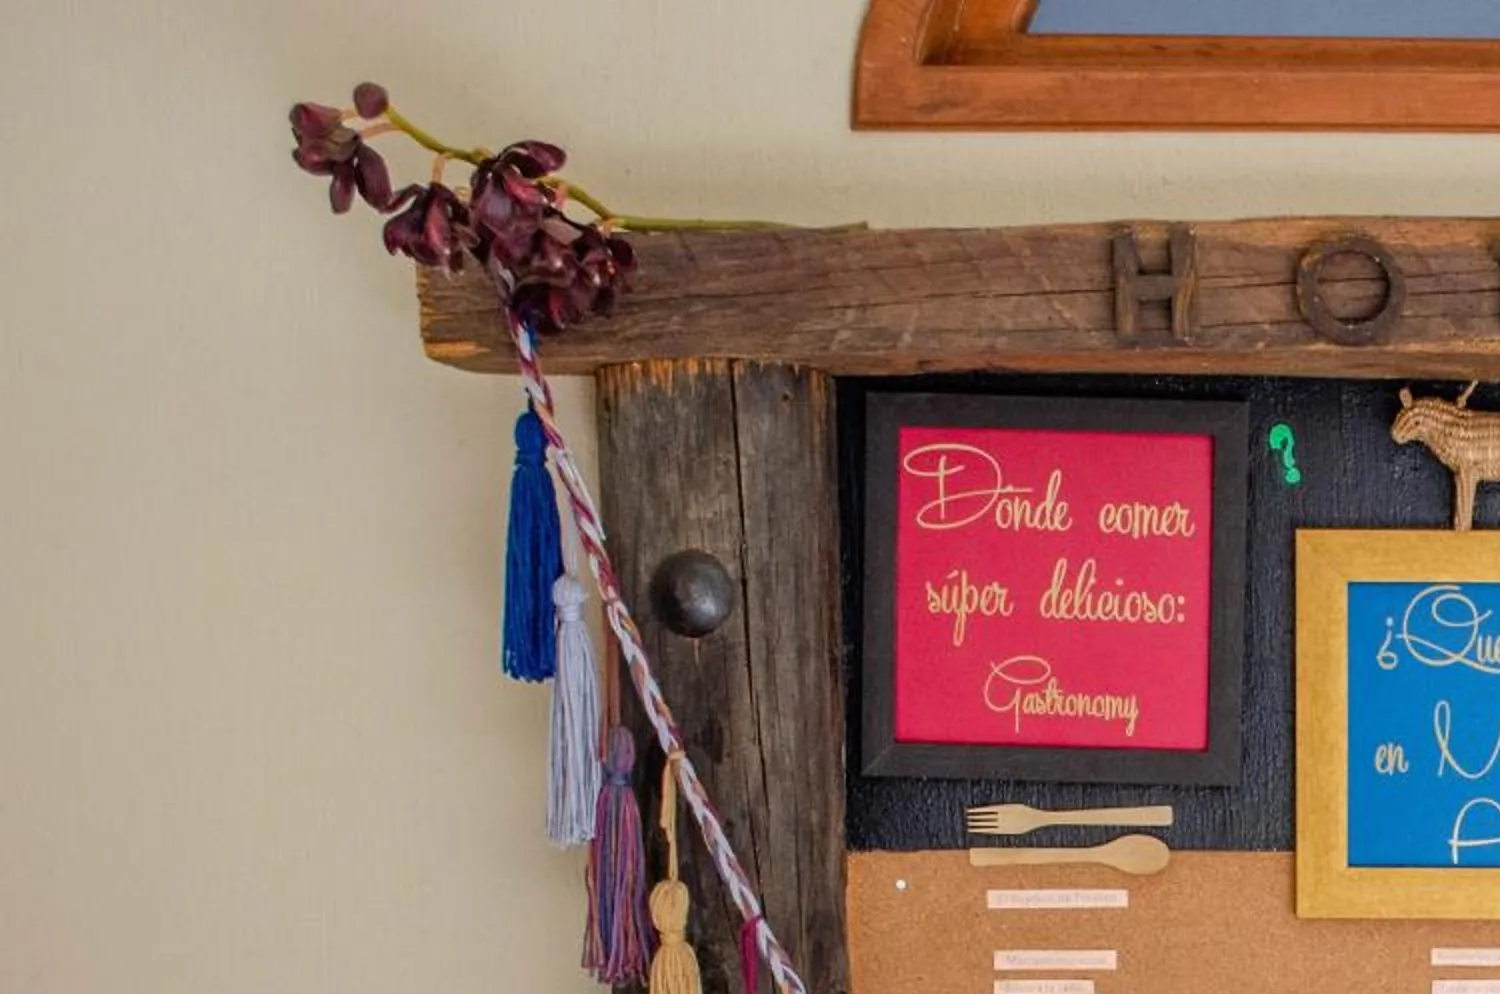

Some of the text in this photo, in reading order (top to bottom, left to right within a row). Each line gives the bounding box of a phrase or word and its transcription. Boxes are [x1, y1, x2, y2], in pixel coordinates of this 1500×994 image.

[1099, 501, 1195, 538] comer
[926, 558, 1186, 646] súper delicioso:
[985, 656, 1139, 737] Gastronomy
[1375, 742, 1409, 774] en
